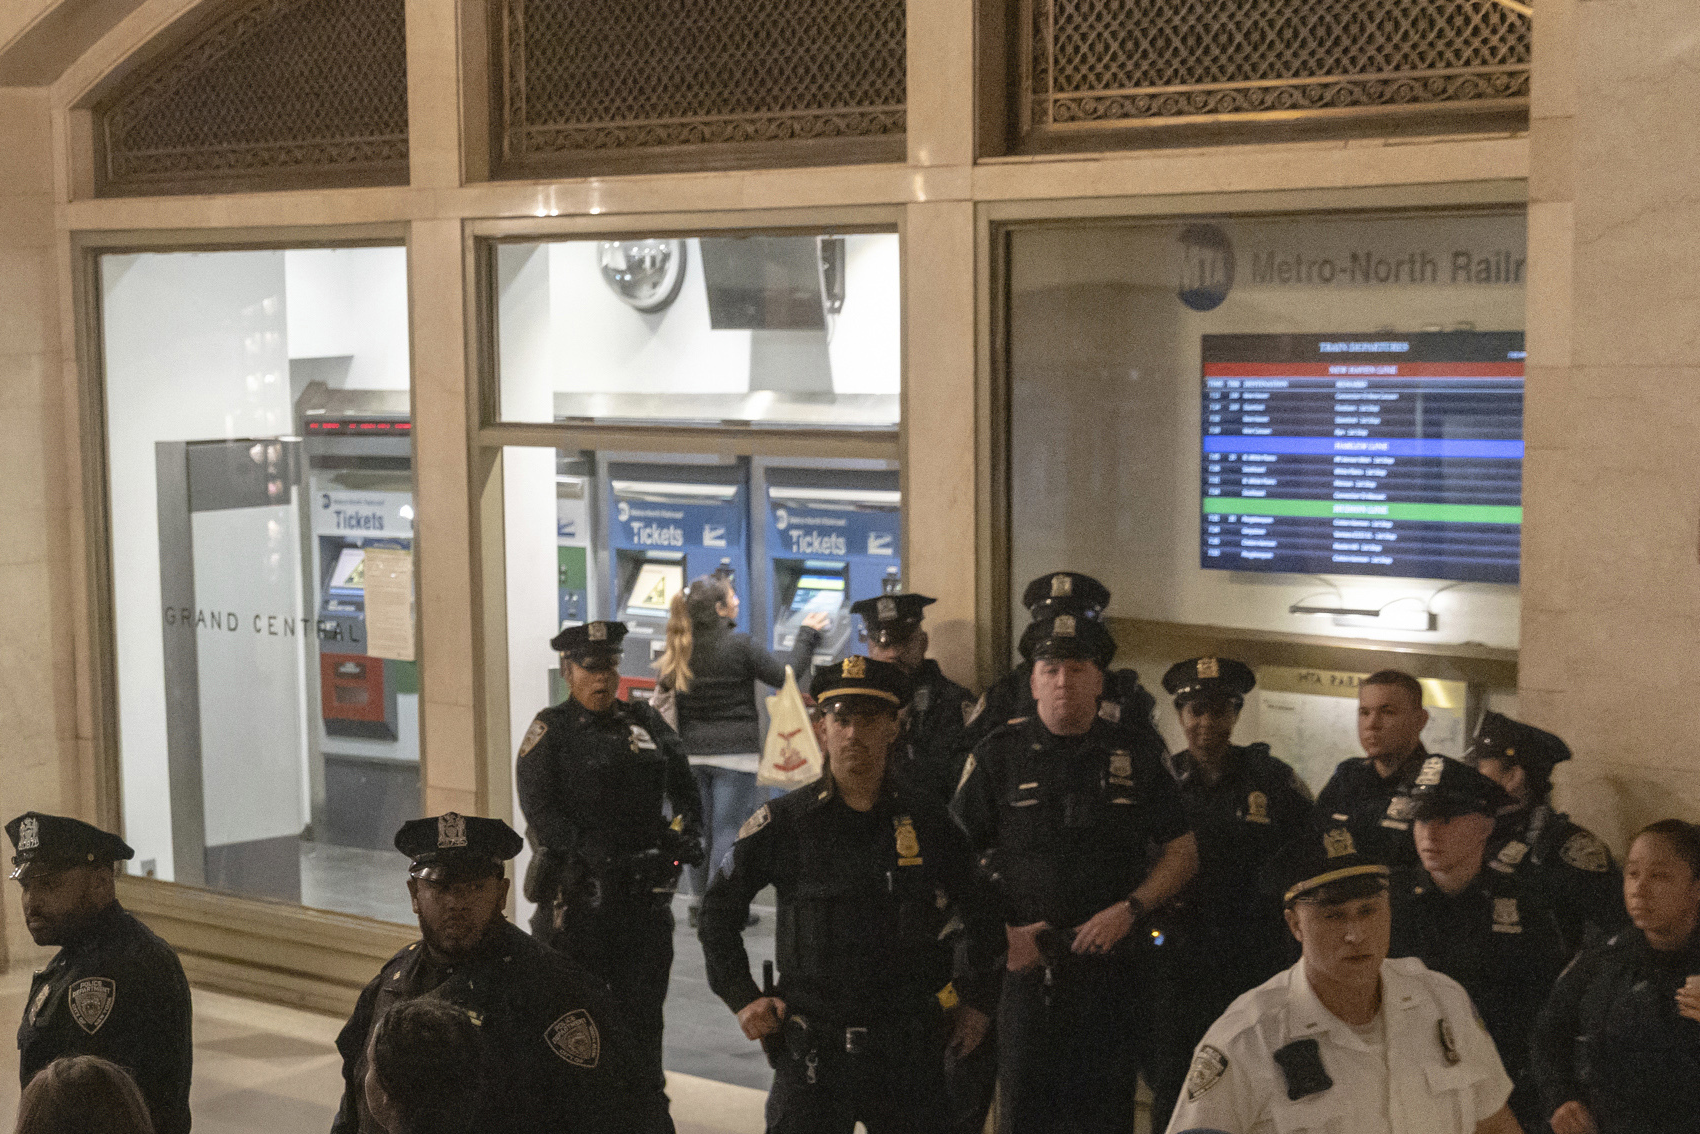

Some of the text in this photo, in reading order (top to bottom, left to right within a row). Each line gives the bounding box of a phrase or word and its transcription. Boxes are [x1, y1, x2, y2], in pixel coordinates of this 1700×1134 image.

[1252, 249, 1439, 285] Metro-North
[332, 509, 385, 531] Tickets
[629, 521, 685, 547] Tickets
[788, 529, 848, 556] Tickets
[164, 606, 362, 644] GRAND CENTRAL
